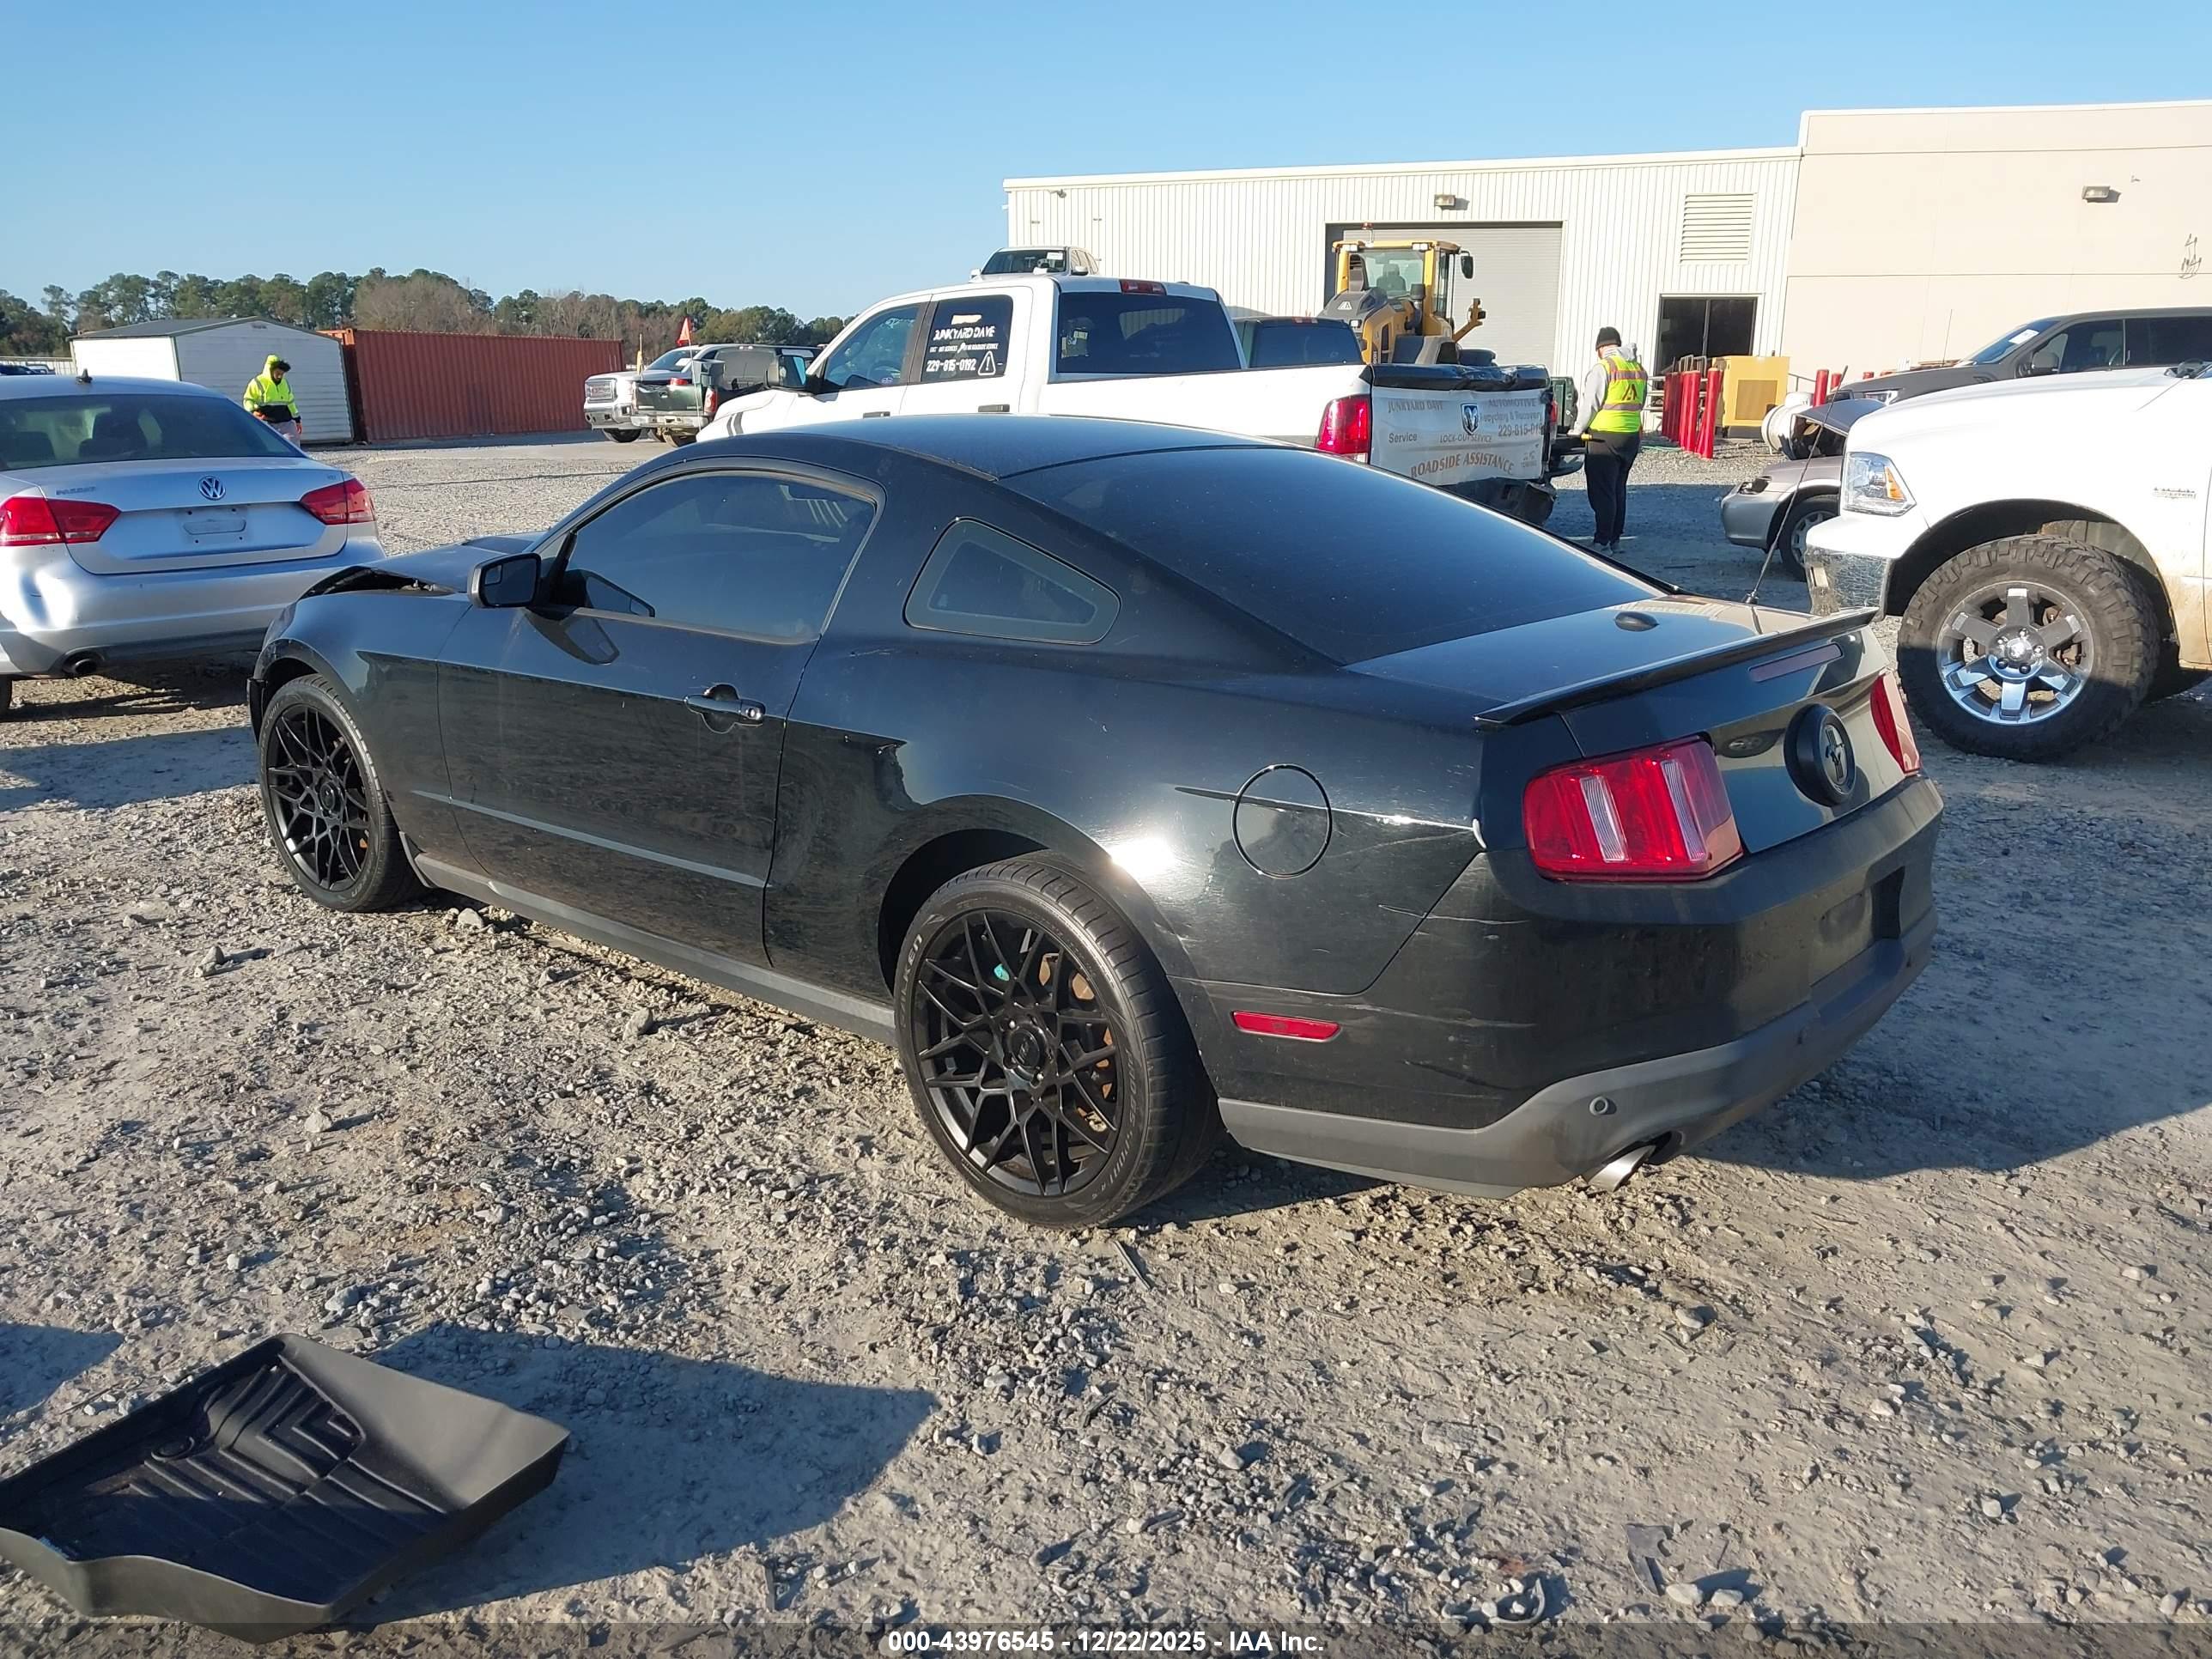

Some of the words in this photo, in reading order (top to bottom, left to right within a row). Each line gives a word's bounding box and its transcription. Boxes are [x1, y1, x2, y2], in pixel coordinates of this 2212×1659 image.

[933, 327, 973, 341] JUNKYARD
[974, 325, 995, 337] DAVE
[926, 358, 976, 372] 229-815-0192
[1488, 398, 1537, 407] AUTOMOTIVE
[1388, 432, 1418, 444] Service
[1409, 454, 1461, 478] ROADSIDE
[1462, 452, 1514, 476] ASSISTANCE
